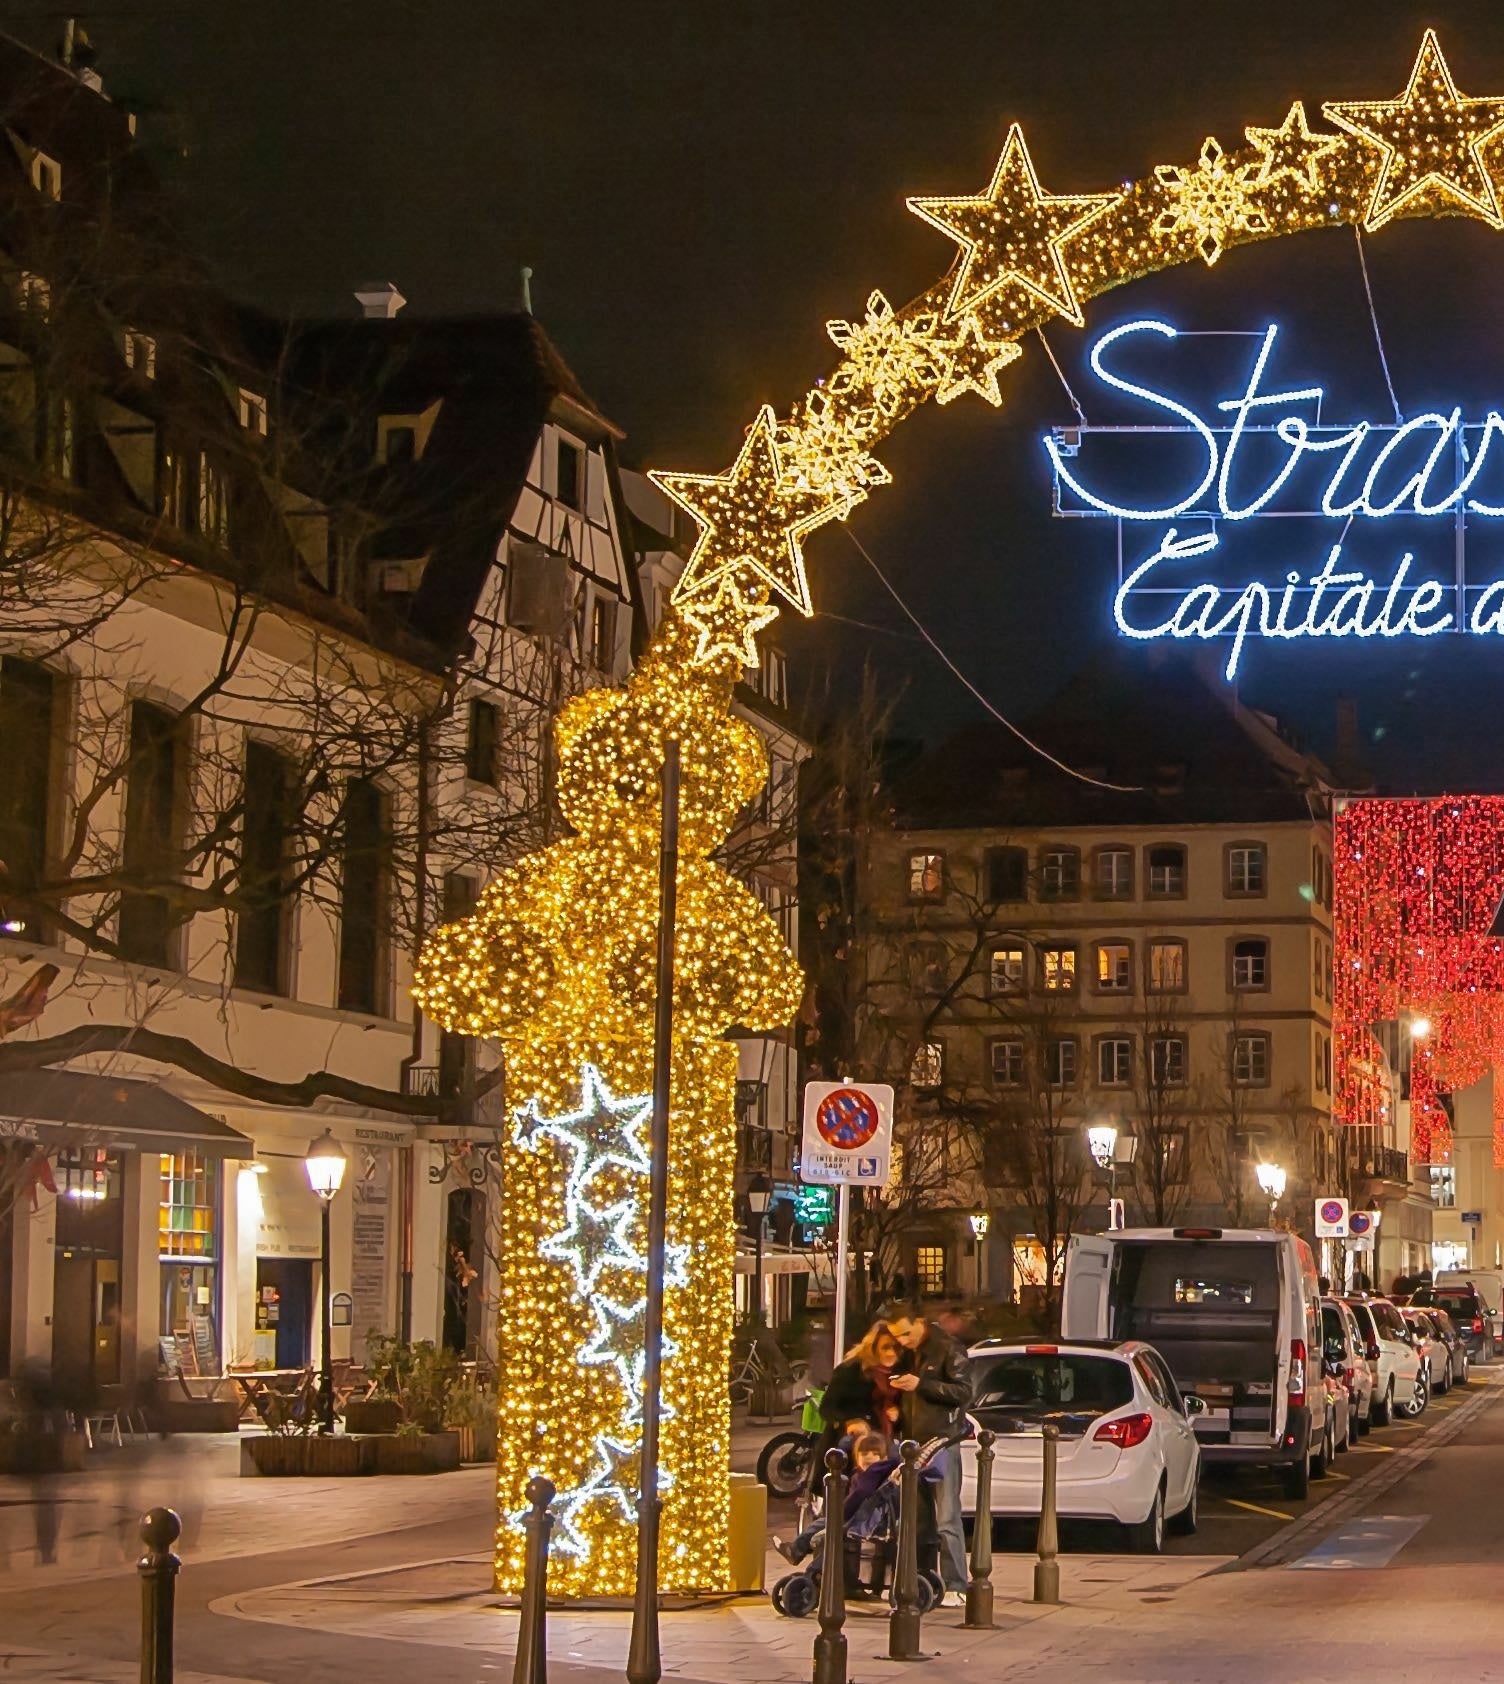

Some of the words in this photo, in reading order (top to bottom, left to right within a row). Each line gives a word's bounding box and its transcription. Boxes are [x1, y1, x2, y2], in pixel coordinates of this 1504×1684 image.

[1113, 528, 1453, 681] Capitale
[355, 1128, 405, 1142] RESTAURANT
[816, 1155, 850, 1163] INTERDIT
